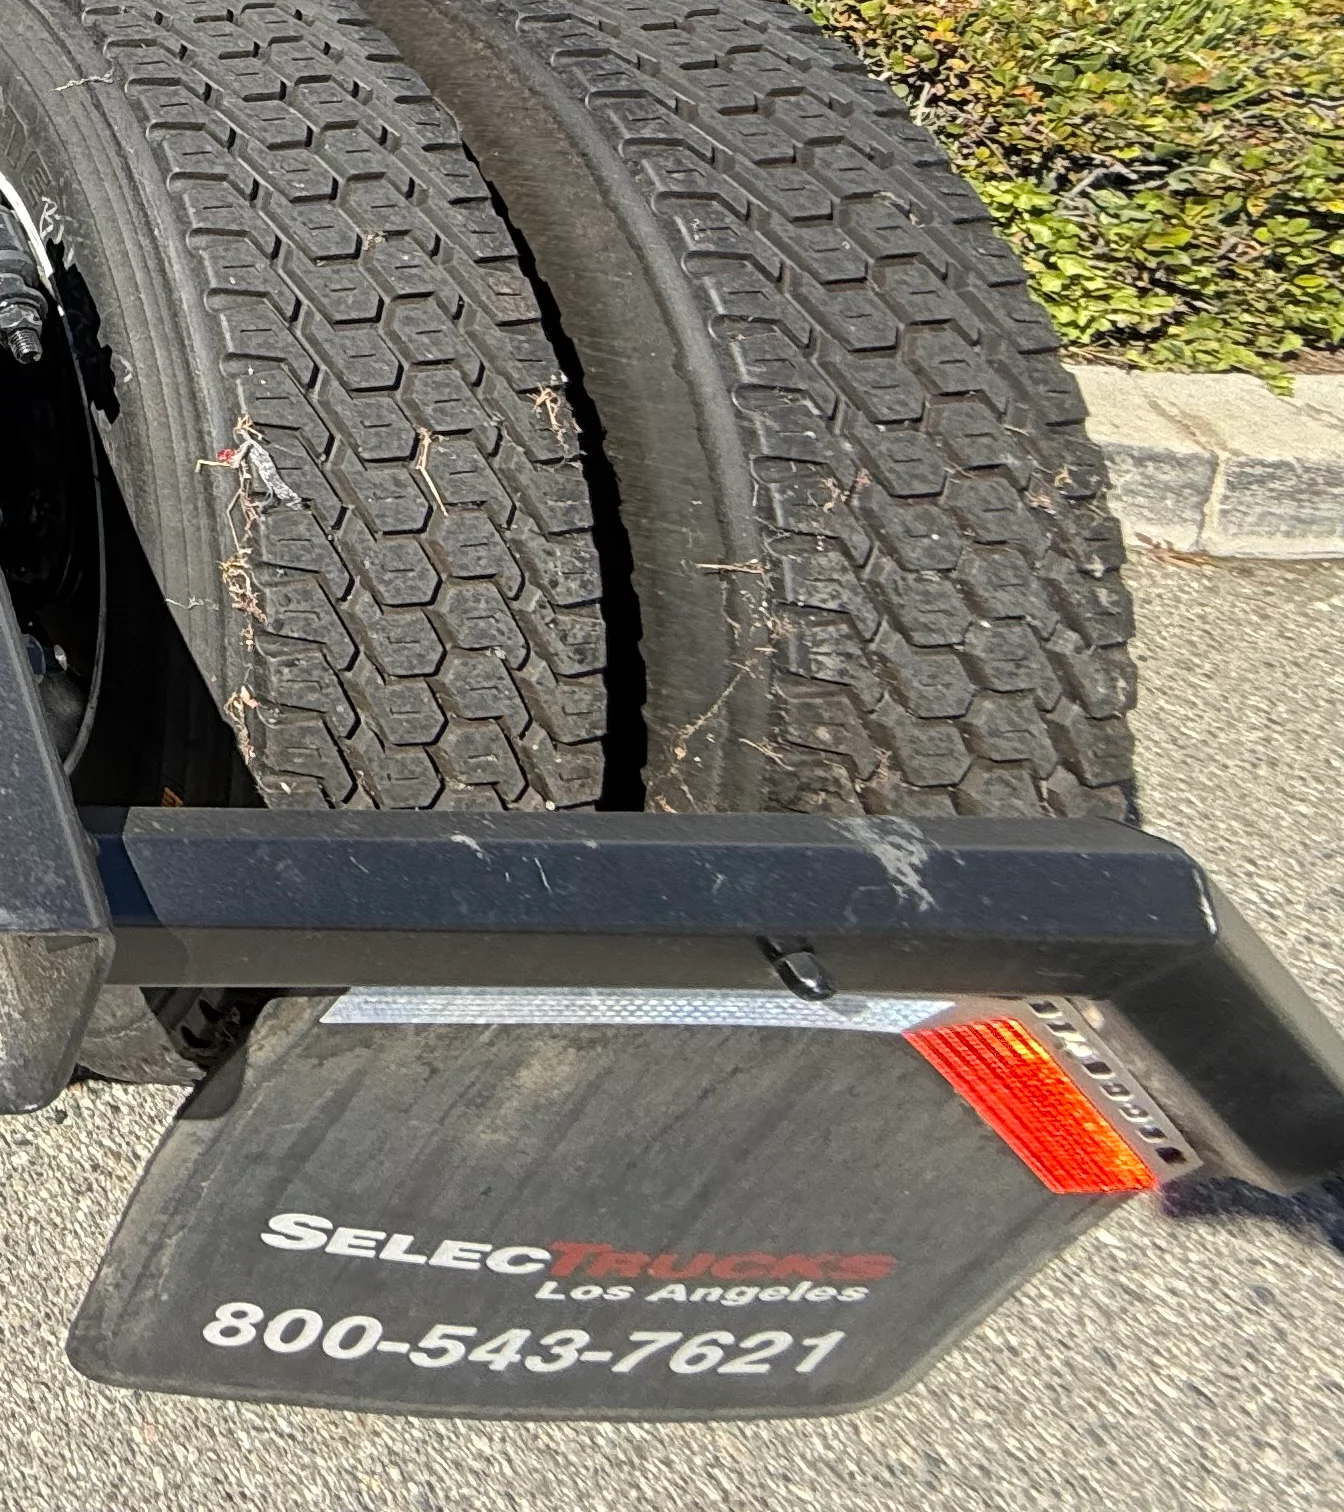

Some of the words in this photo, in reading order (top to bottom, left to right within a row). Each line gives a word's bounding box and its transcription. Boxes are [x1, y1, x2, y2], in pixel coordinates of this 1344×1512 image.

[535, 1280, 635, 1302] Los
[644, 1281, 871, 1306] Angeles
[202, 1301, 846, 1375] 800-543-7621
